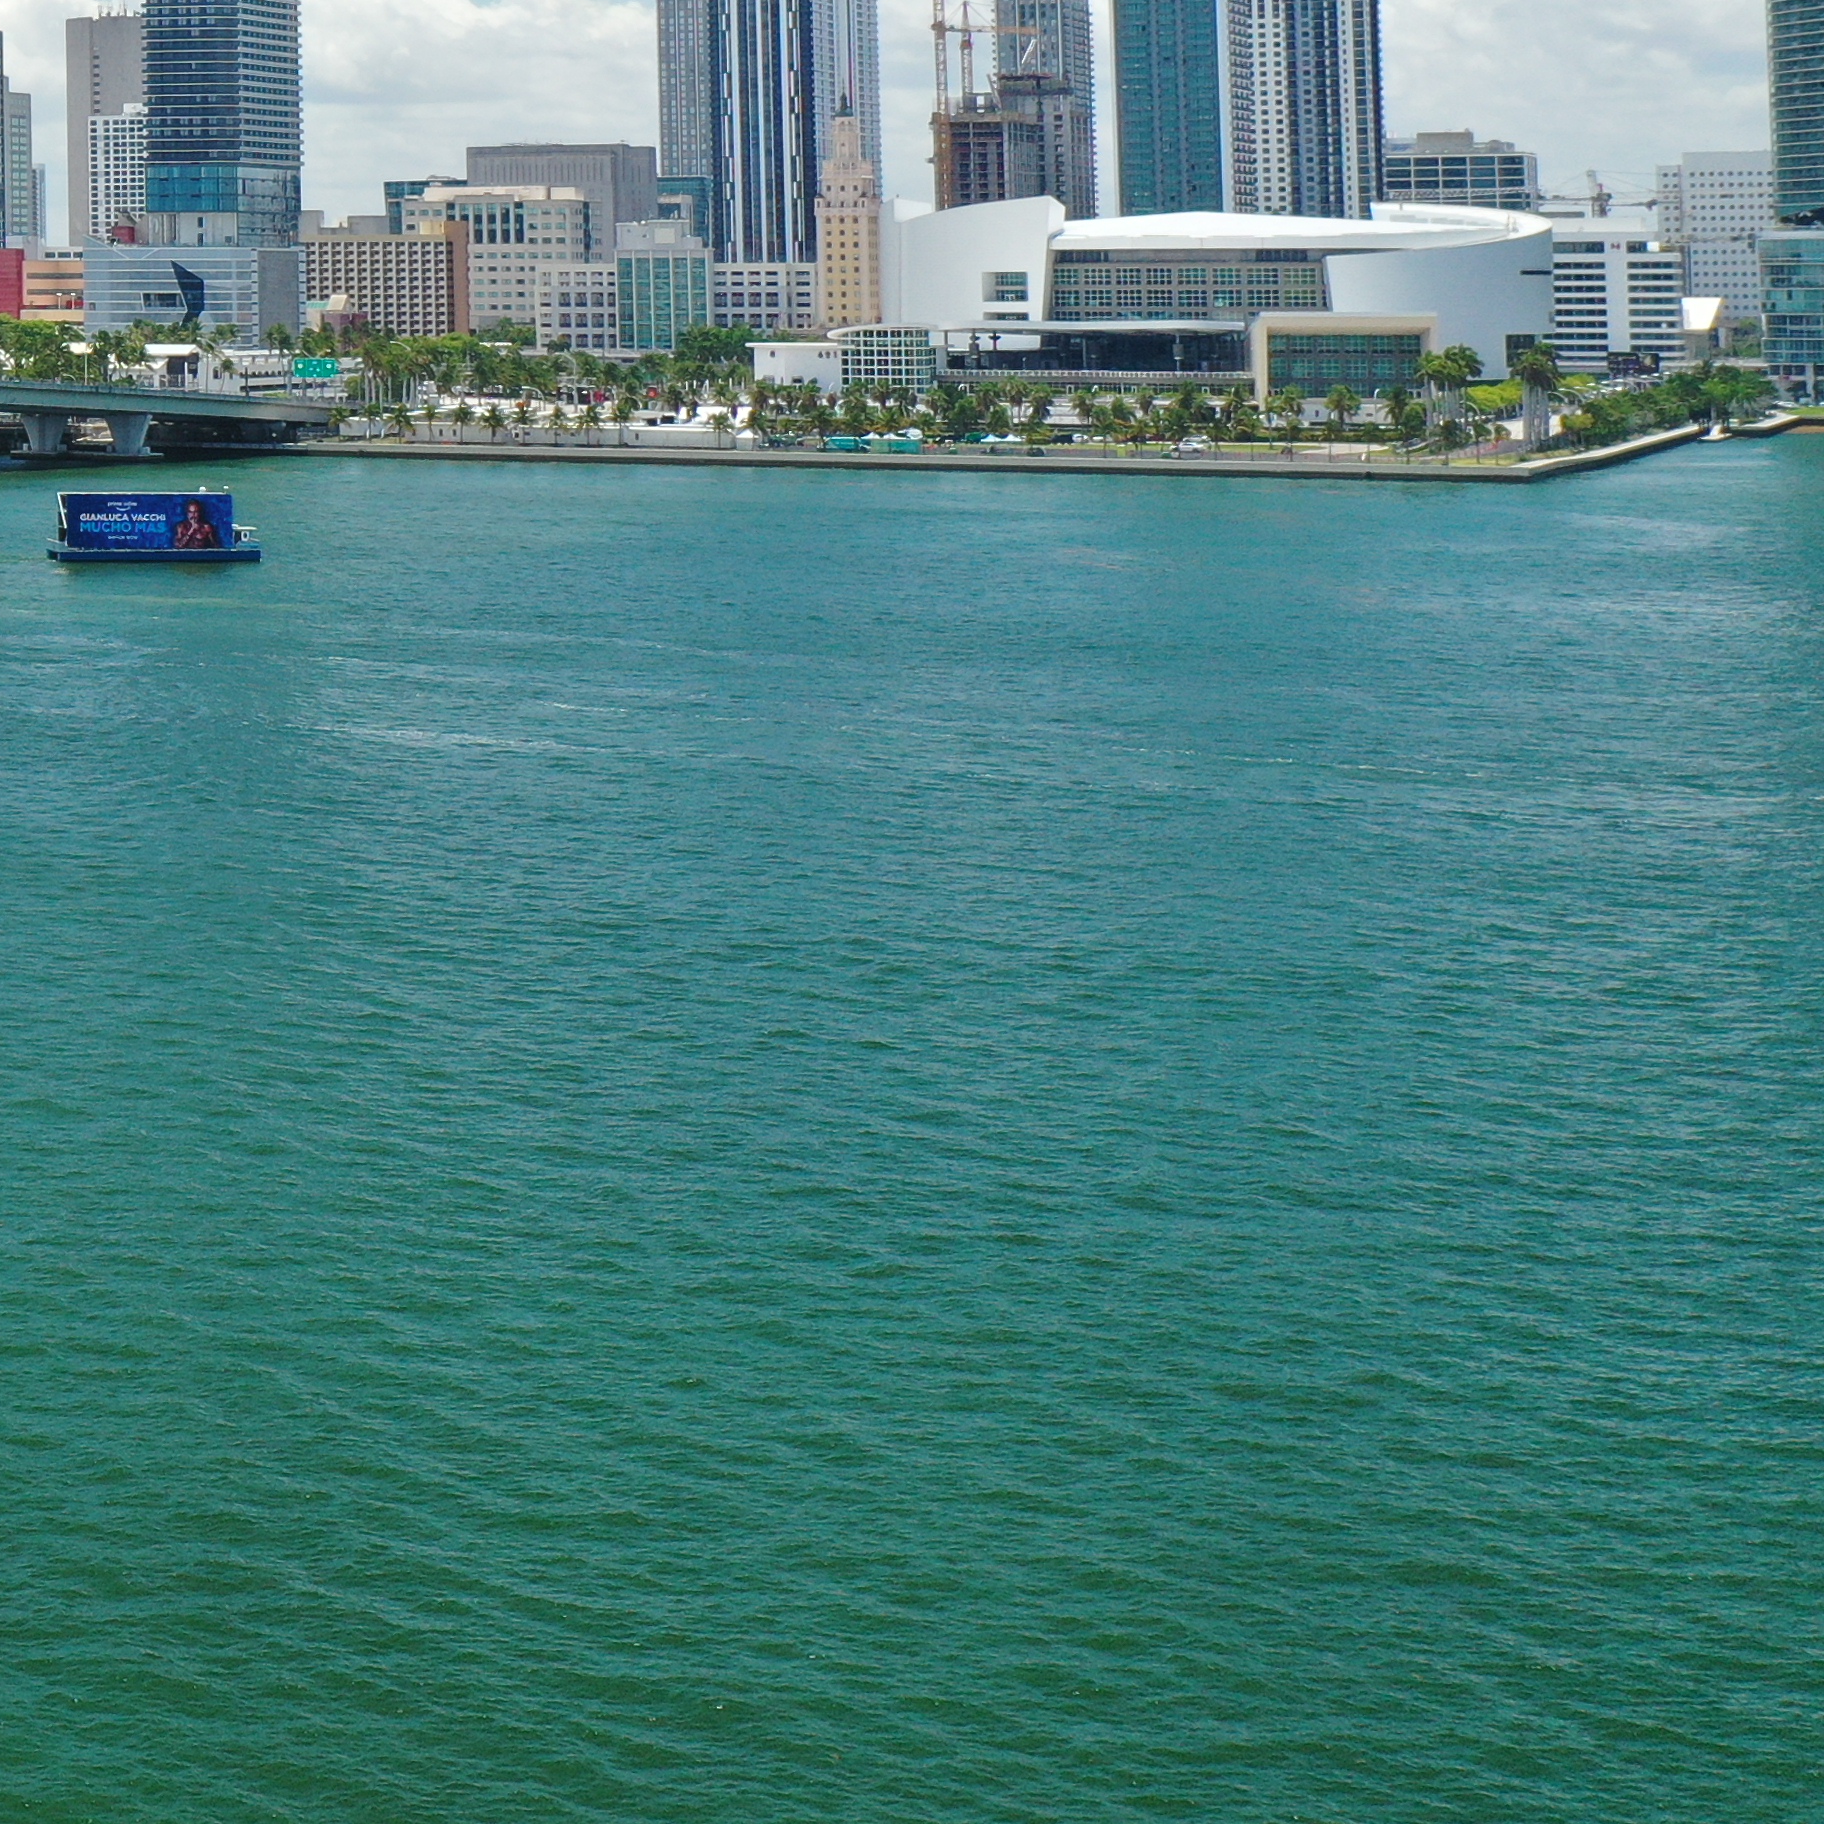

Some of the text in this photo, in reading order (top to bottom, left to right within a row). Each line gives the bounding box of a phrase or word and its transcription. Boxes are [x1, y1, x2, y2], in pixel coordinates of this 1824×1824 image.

[80, 513, 166, 522] GIANLUCA VACCHI
[80, 522, 131, 532] MUCHO
